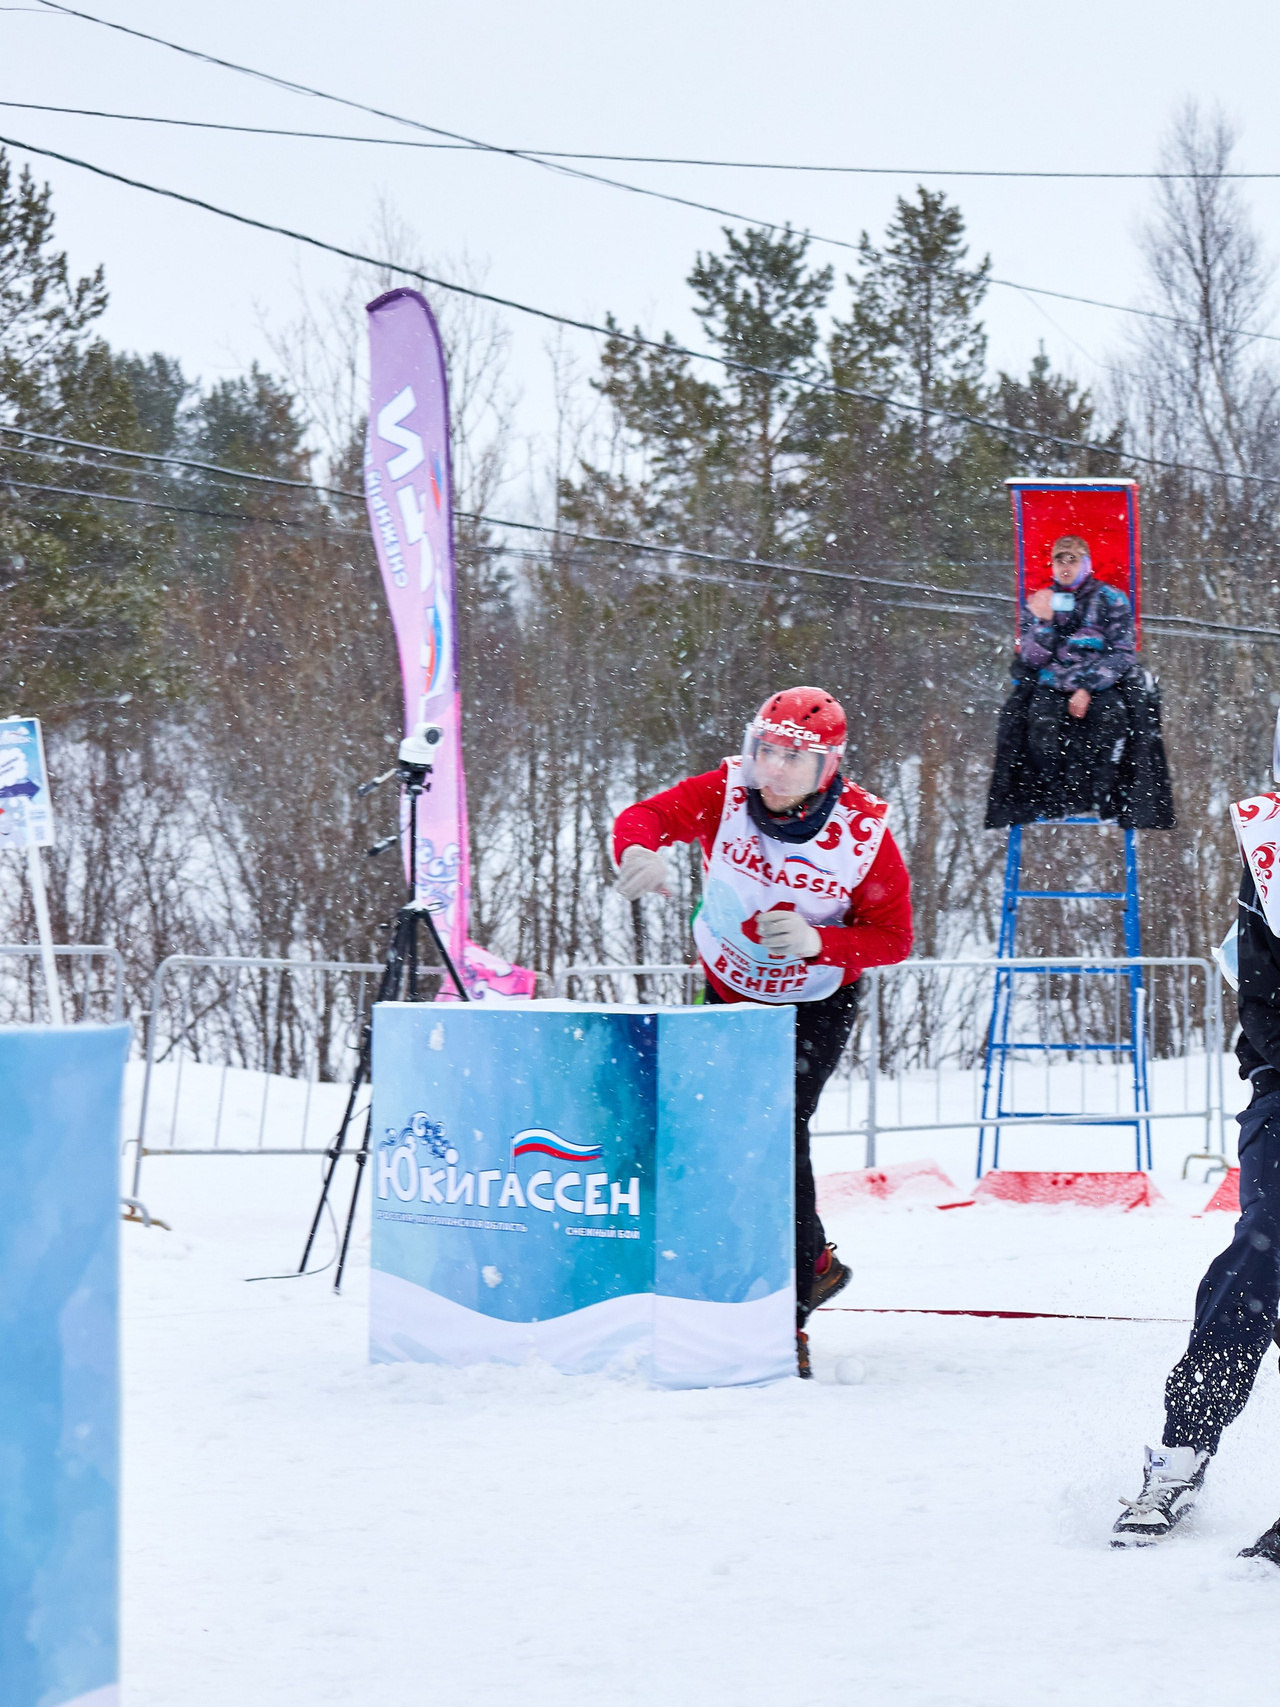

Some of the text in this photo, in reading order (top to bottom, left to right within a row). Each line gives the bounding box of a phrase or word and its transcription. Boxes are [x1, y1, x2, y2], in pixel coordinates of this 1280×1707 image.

[730, 970, 808, 993] СНЕГЕ
[756, 964, 808, 978] ТОЛК
[377, 1146, 641, 1216] ЮКИГАССЕН
